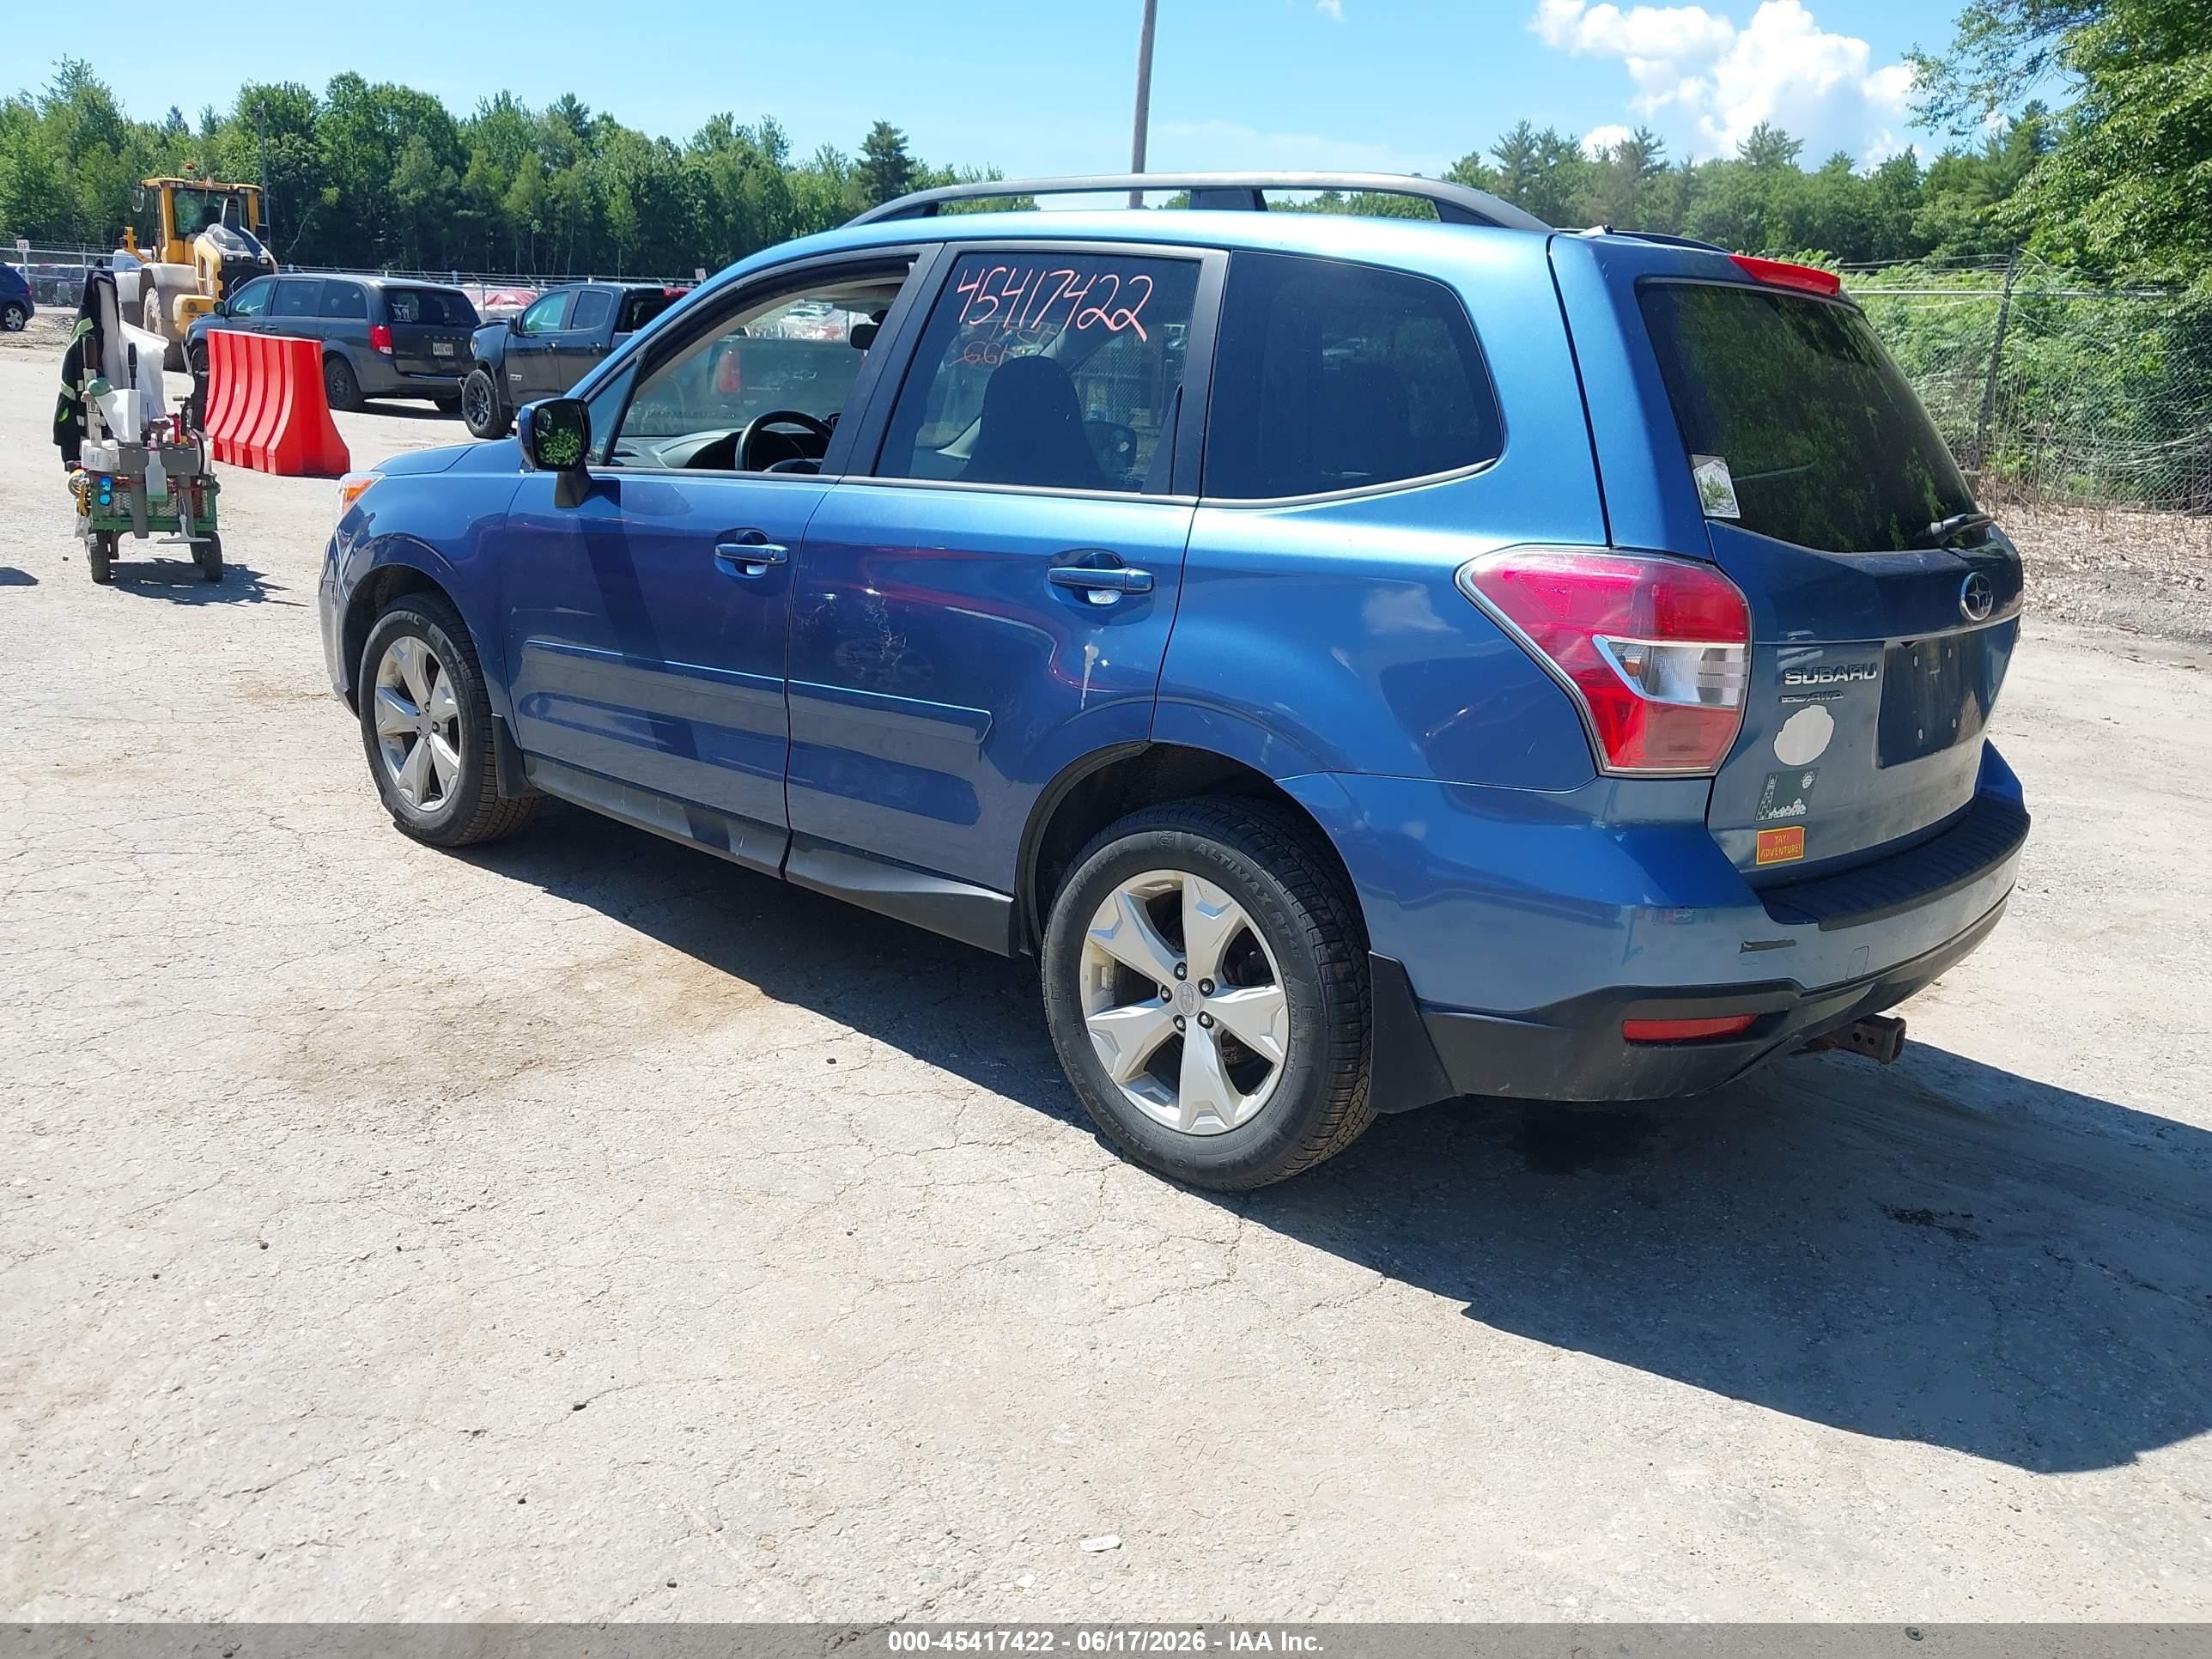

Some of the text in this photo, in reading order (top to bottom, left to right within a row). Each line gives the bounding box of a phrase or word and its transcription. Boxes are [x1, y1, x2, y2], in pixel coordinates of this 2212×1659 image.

[957, 266, 1153, 343] 45417422
[1784, 663, 1878, 685] SUBARU
[1760, 844, 1802, 859] ADVENTURE!
[1193, 842, 1273, 905] ALTIMAX
